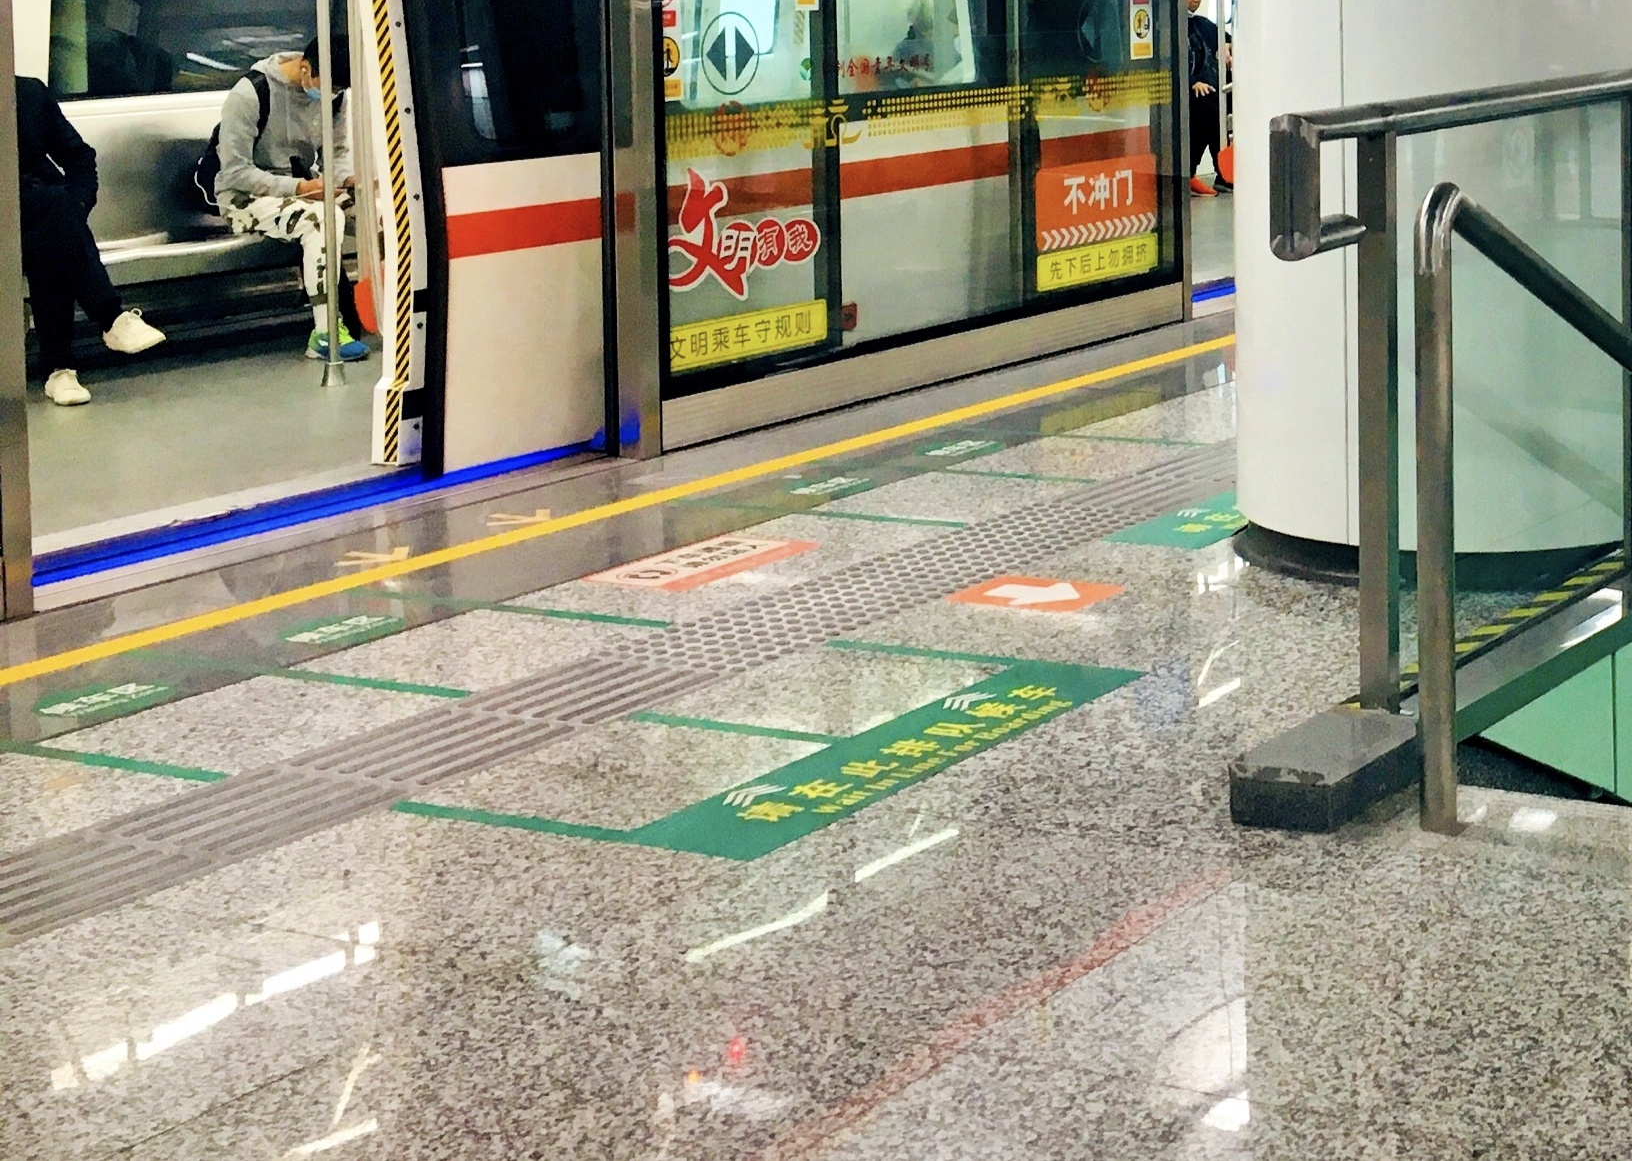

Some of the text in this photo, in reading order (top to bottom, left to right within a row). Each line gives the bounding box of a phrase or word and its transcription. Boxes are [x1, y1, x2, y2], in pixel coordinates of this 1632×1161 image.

[1063, 169, 1134, 215] 不冲门
[1050, 242, 1148, 281] 先下后上勿拥挤
[670, 310, 811, 361] 文明乘车守规则
[736, 684, 1057, 823] 请在此排队候车
[811, 699, 1074, 814] Wait In Line For Boarding
